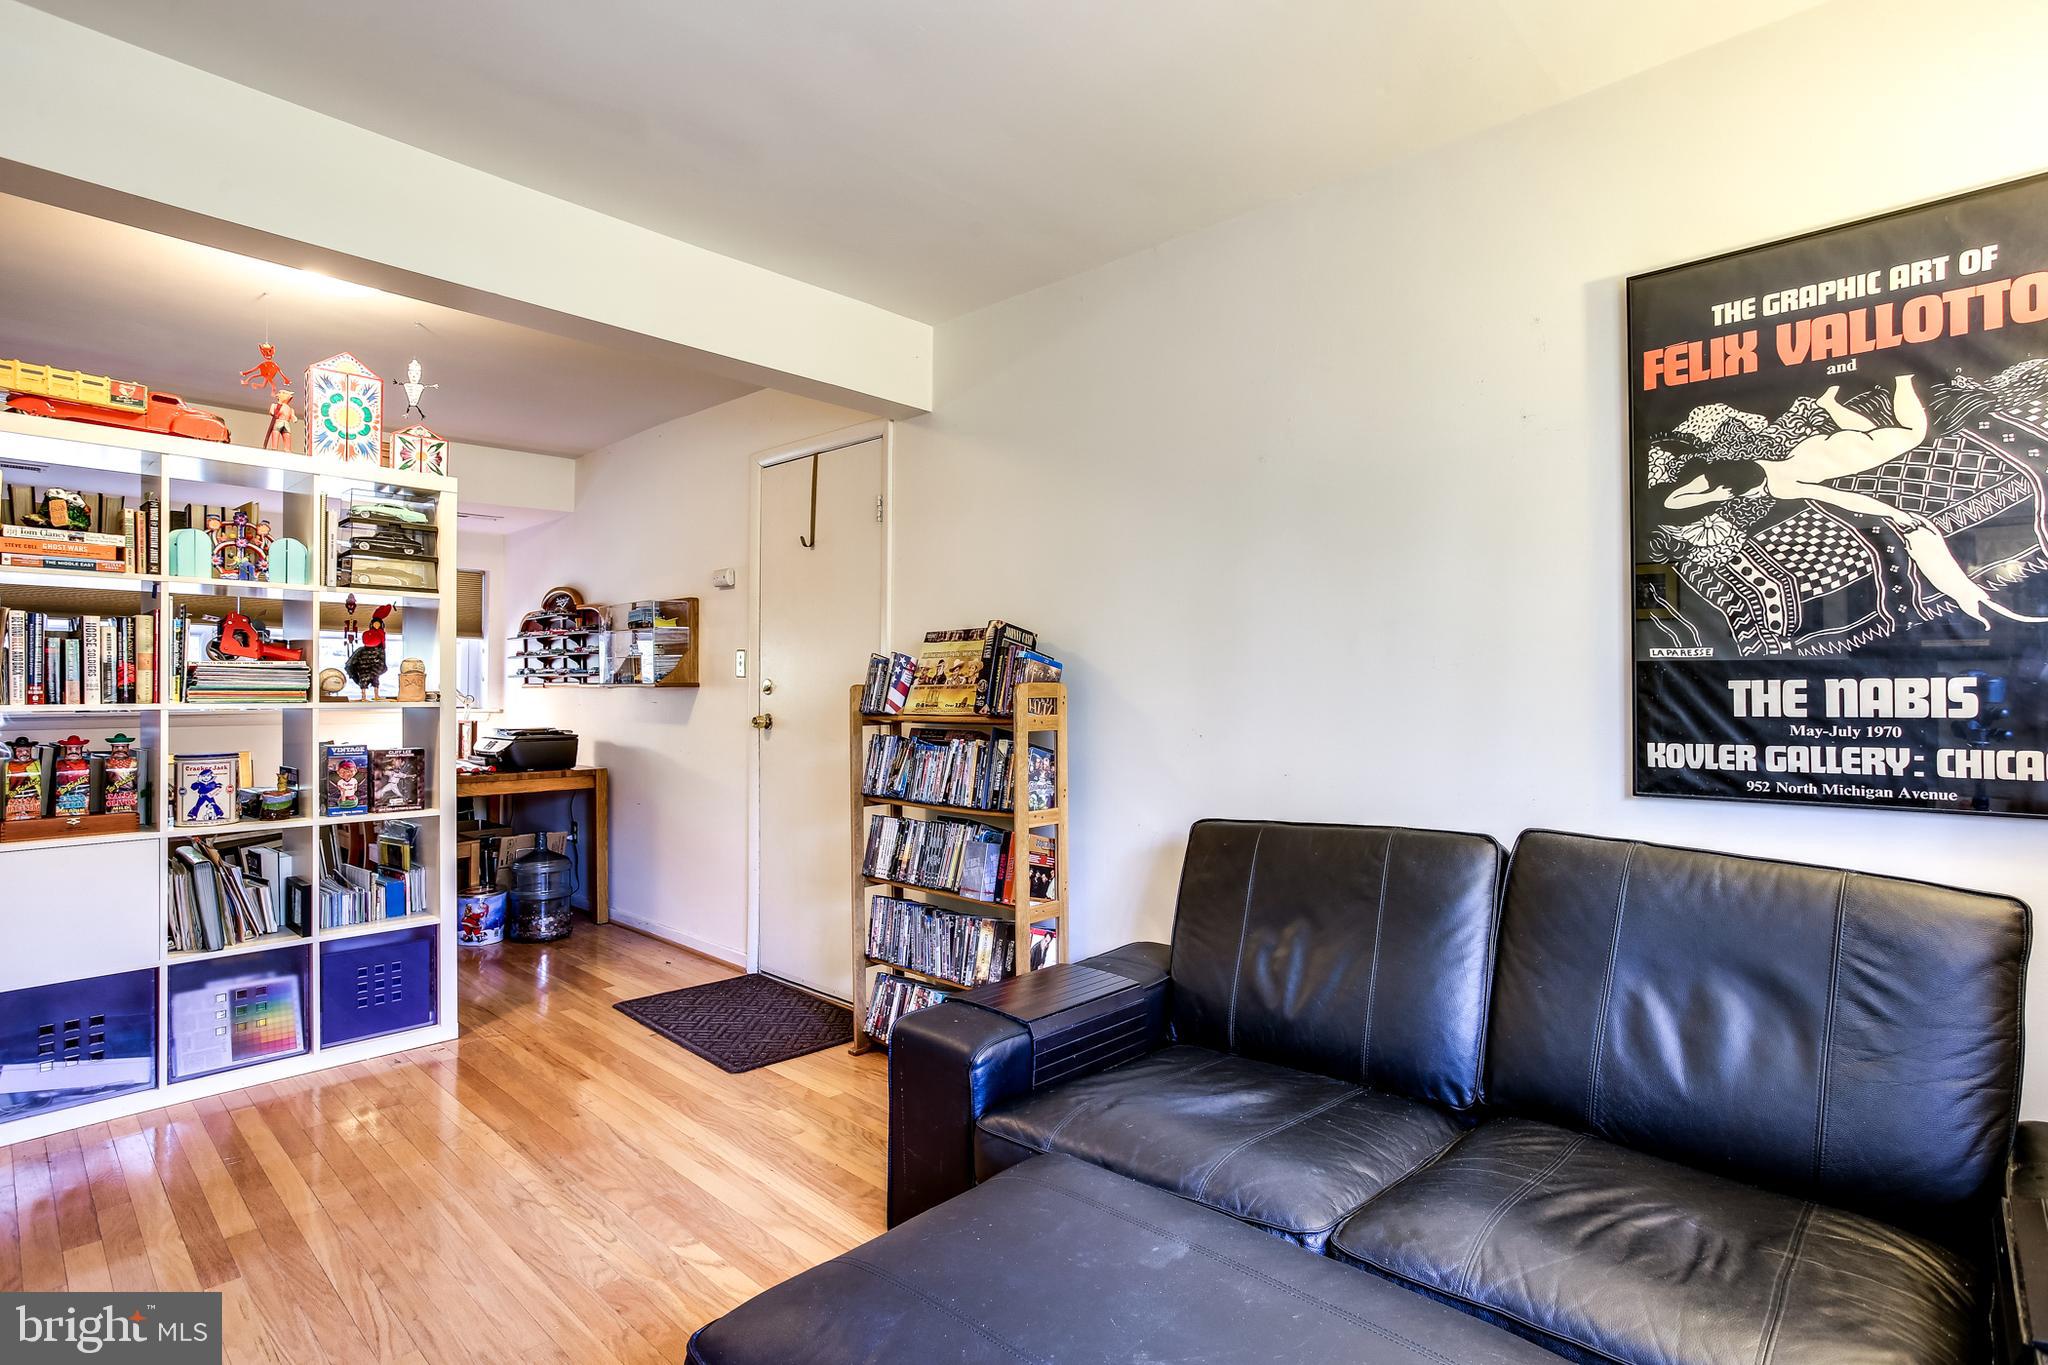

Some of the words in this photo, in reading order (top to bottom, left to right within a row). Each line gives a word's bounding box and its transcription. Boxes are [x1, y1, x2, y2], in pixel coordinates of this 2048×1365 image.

[1711, 297, 1756, 327] THE
[1762, 270, 1882, 317] GRAPHIC
[1889, 255, 1950, 291] ART
[1958, 244, 1999, 276] OF
[1826, 358, 1858, 376] and
[20, 528, 38, 536] Tom
[42, 543, 66, 552] GHOST
[67, 544, 88, 553] WARS
[11, 617, 24, 637] BEYOND
[85, 622, 98, 647] HORSE
[1650, 648, 1665, 657] LA
[1665, 648, 1713, 657] PARESSE
[87, 649, 97, 678] SOLDIERS
[1728, 679, 1808, 719] THE
[1825, 676, 1979, 719] NABIS
[1789, 724, 1862, 740] May-July
[1866, 726, 1902, 739] 1970
[1646, 742, 1757, 772] KOVLER
[1936, 748, 2048, 781] CHICA
[1746, 781, 1771, 793] 952
[1776, 782, 1818, 796] North
[1822, 784, 1894, 801] Michigan
[1898, 787, 1958, 802] Avenue
